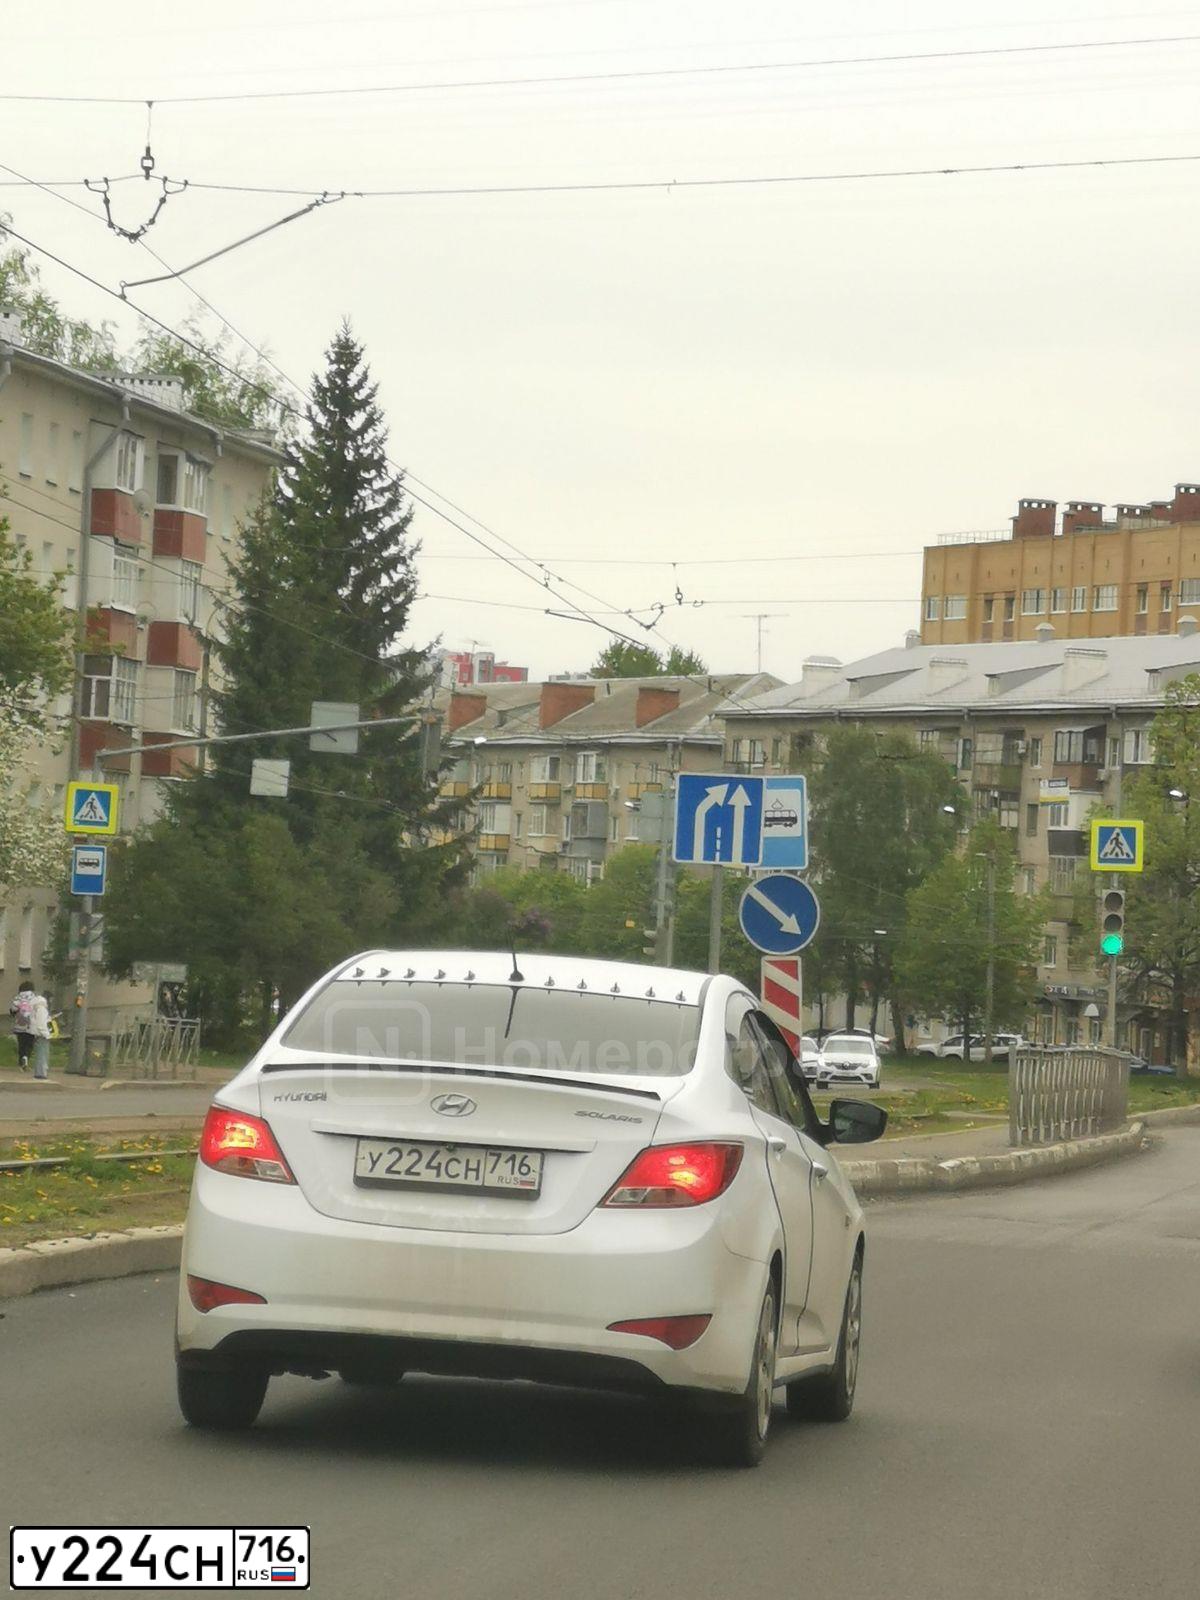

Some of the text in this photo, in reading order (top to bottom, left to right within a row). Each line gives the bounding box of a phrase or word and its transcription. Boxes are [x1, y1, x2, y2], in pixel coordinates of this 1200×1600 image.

[273, 1091, 328, 1102] HYUNDAI
[574, 1110, 643, 1124] SOLARIS
[368, 1146, 532, 1181] У224СН 716
[497, 1174, 520, 1186] RUS
